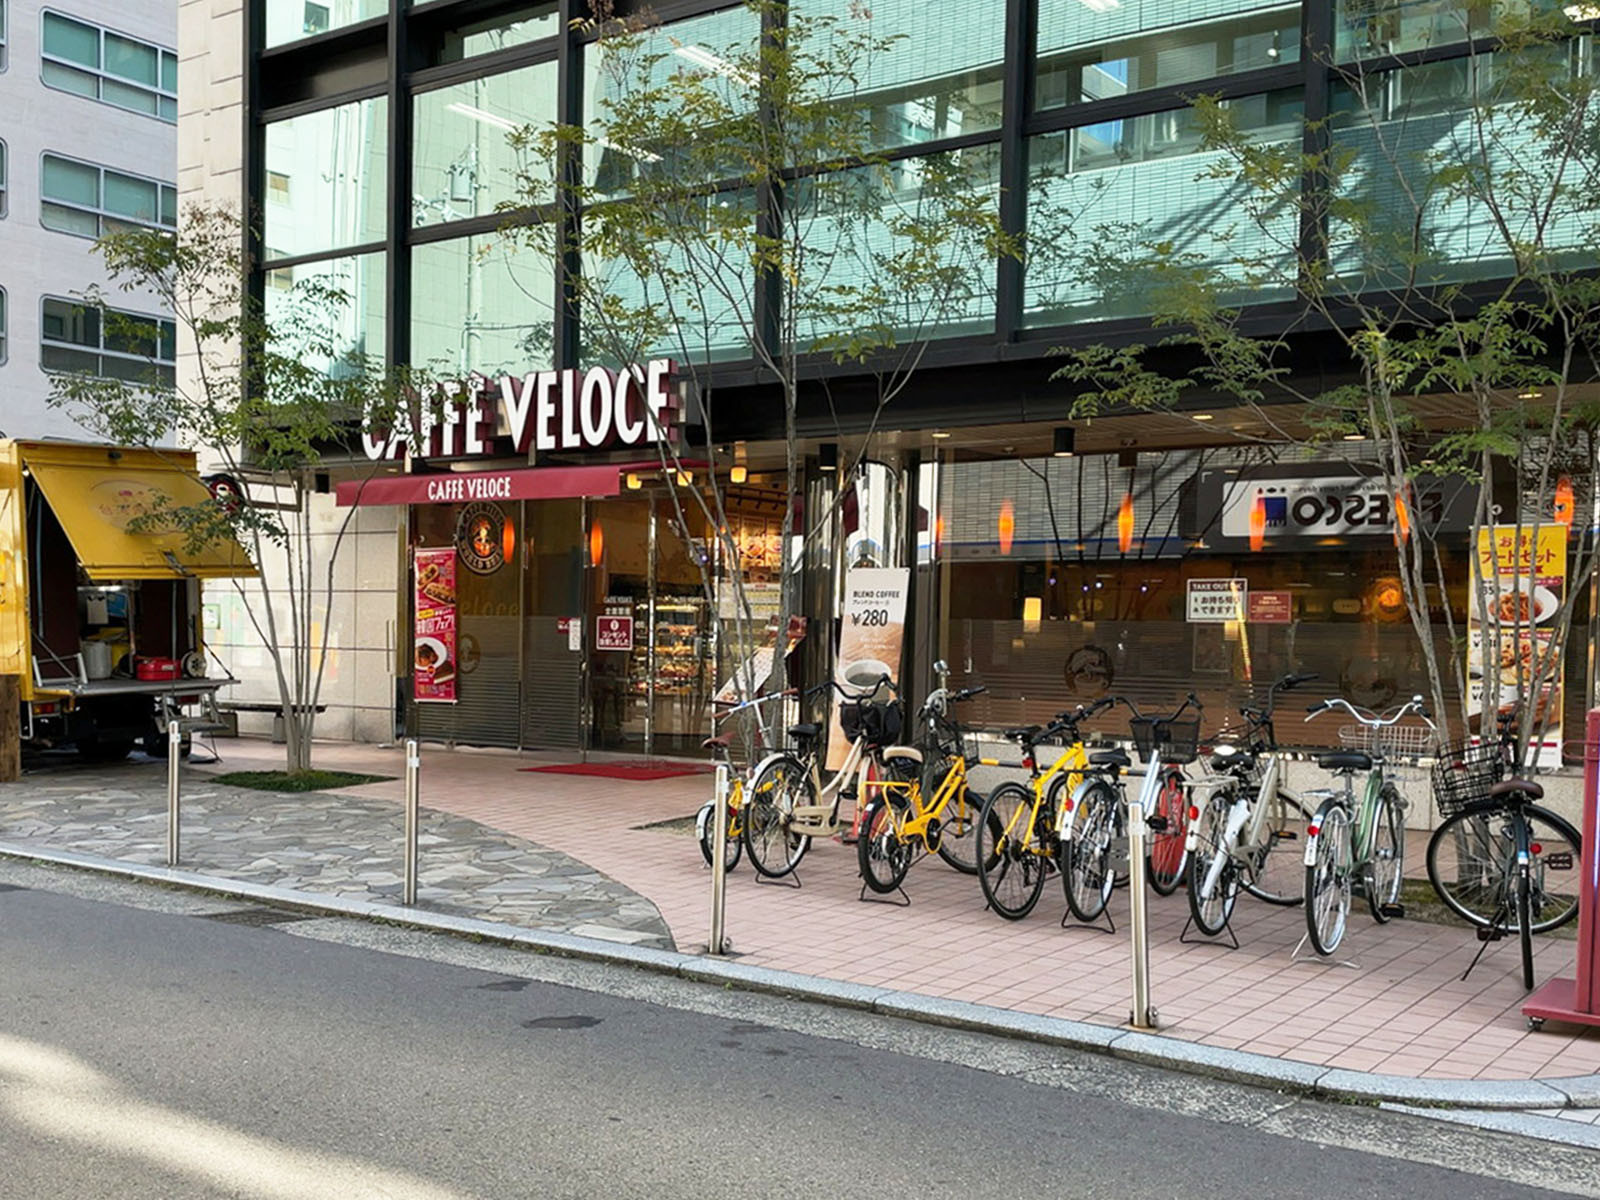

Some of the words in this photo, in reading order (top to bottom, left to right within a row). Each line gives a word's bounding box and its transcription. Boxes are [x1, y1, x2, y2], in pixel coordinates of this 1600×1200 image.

[500, 358, 669, 452] VELOCE
[467, 477, 511, 499] VELOCE
[853, 590, 875, 598] BLEND
[875, 590, 900, 598] COFFEE
[851, 609, 889, 627] ¥280
